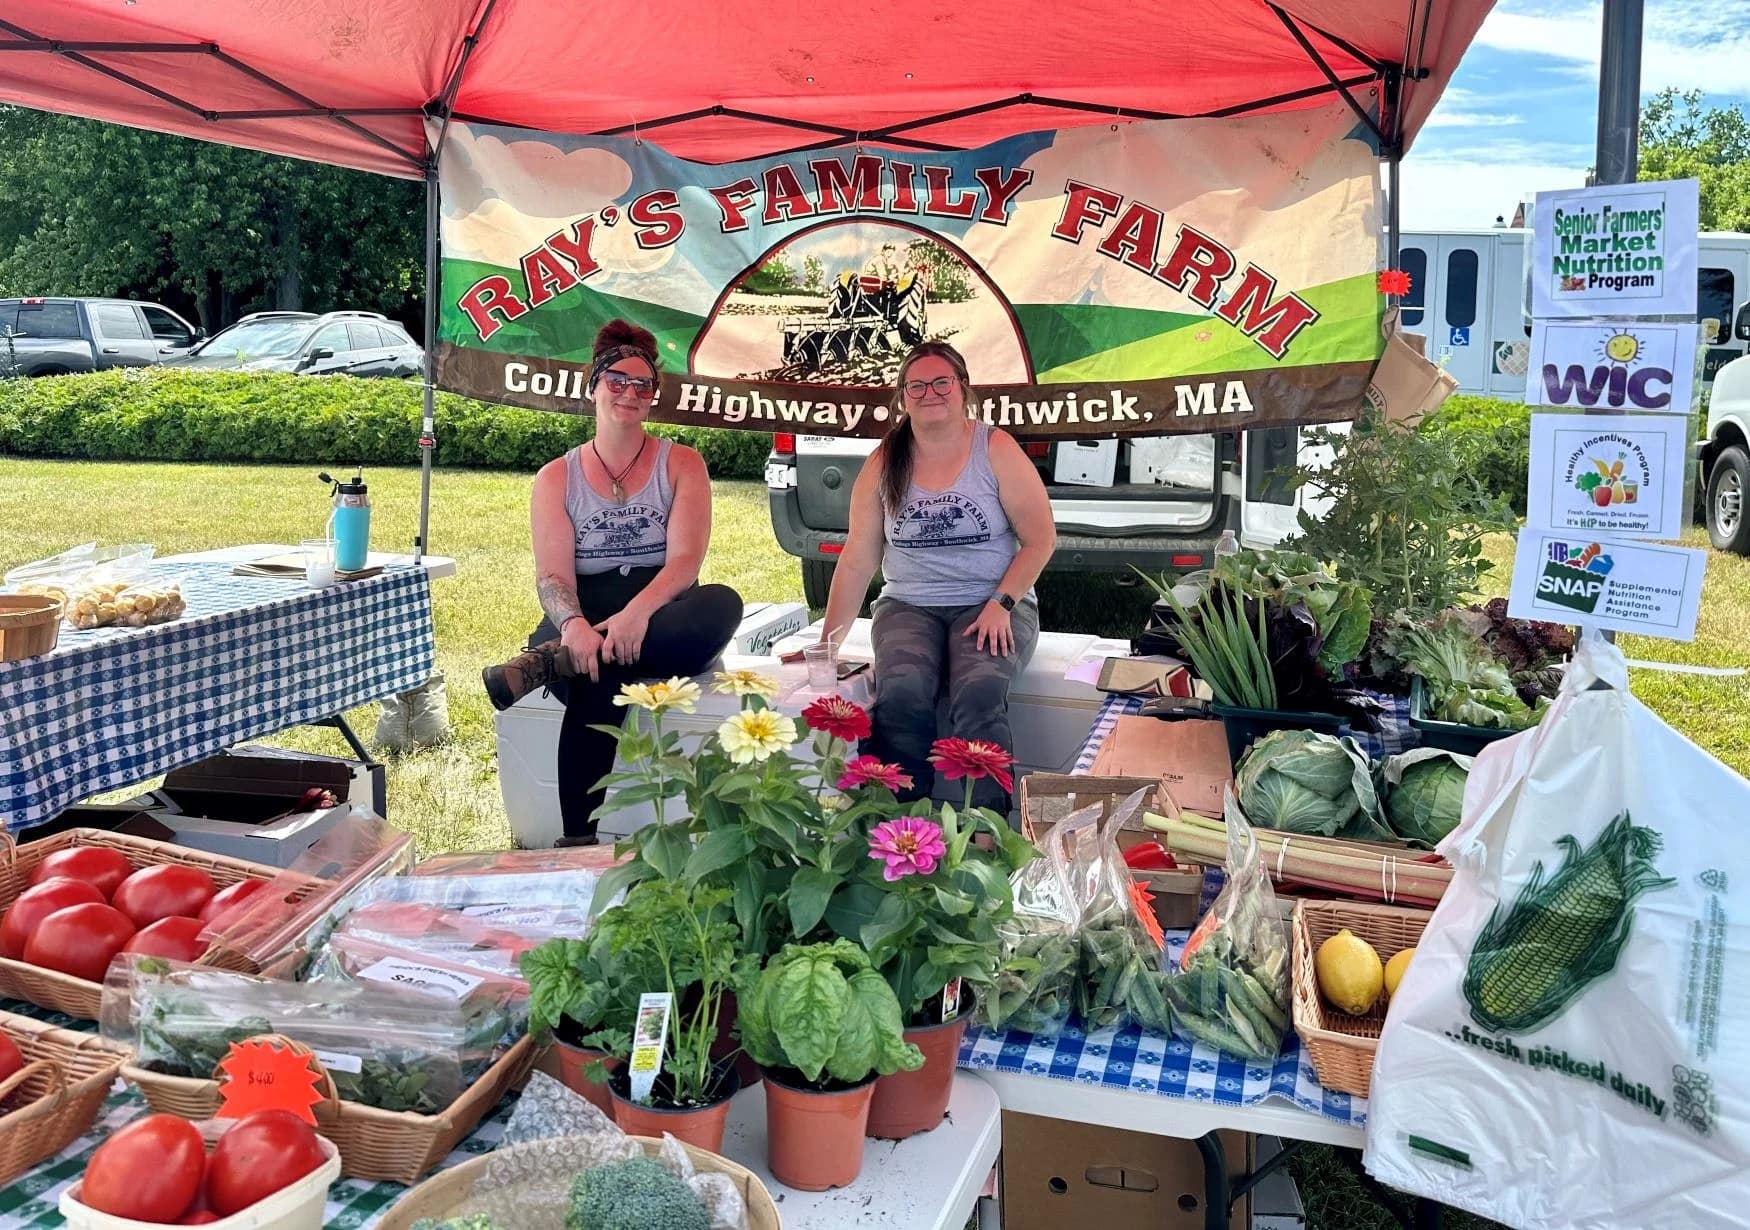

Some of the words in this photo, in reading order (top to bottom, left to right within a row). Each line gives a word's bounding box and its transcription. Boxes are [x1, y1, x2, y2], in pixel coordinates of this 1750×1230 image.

[1554, 207, 1599, 237] Senior
[1602, 201, 1666, 234] Farmers'
[1560, 231, 1656, 254] Market
[457, 189, 687, 344] RAY'S
[708, 155, 1034, 233] FAMILY
[1050, 178, 1322, 361] FARM
[1553, 253, 1664, 275] Nutrition
[1588, 273, 1655, 291] Program
[504, 362, 661, 406] Coll
[676, 383, 865, 432] Highway
[895, 390, 1153, 427] thwick,
[1173, 380, 1254, 417] MA
[1542, 364, 1674, 409] WIC
[1565, 447, 1585, 483] Healthy
[1583, 433, 1633, 449] Incentives
[1632, 445, 1650, 487] Program
[602, 506, 648, 520] FAMILY
[649, 510, 668, 531] FA
[893, 505, 916, 536] RAY'S
[918, 494, 962, 509] FAMILY
[963, 500, 989, 532] FARM
[1567, 518, 1579, 526] It's
[1580, 517, 1598, 529] HIP
[1607, 520, 1618, 528] be
[1619, 521, 1649, 531] healthy!
[1539, 575, 1601, 599] SNAP
[1608, 589, 1652, 601] Nutrition
[1609, 580, 1682, 597] Supplemental
[1605, 606, 1649, 619] Program
[1606, 598, 1661, 612] Assistance
[1527, 1045, 1605, 1082] picked
[1610, 1072, 1666, 1117] daily
